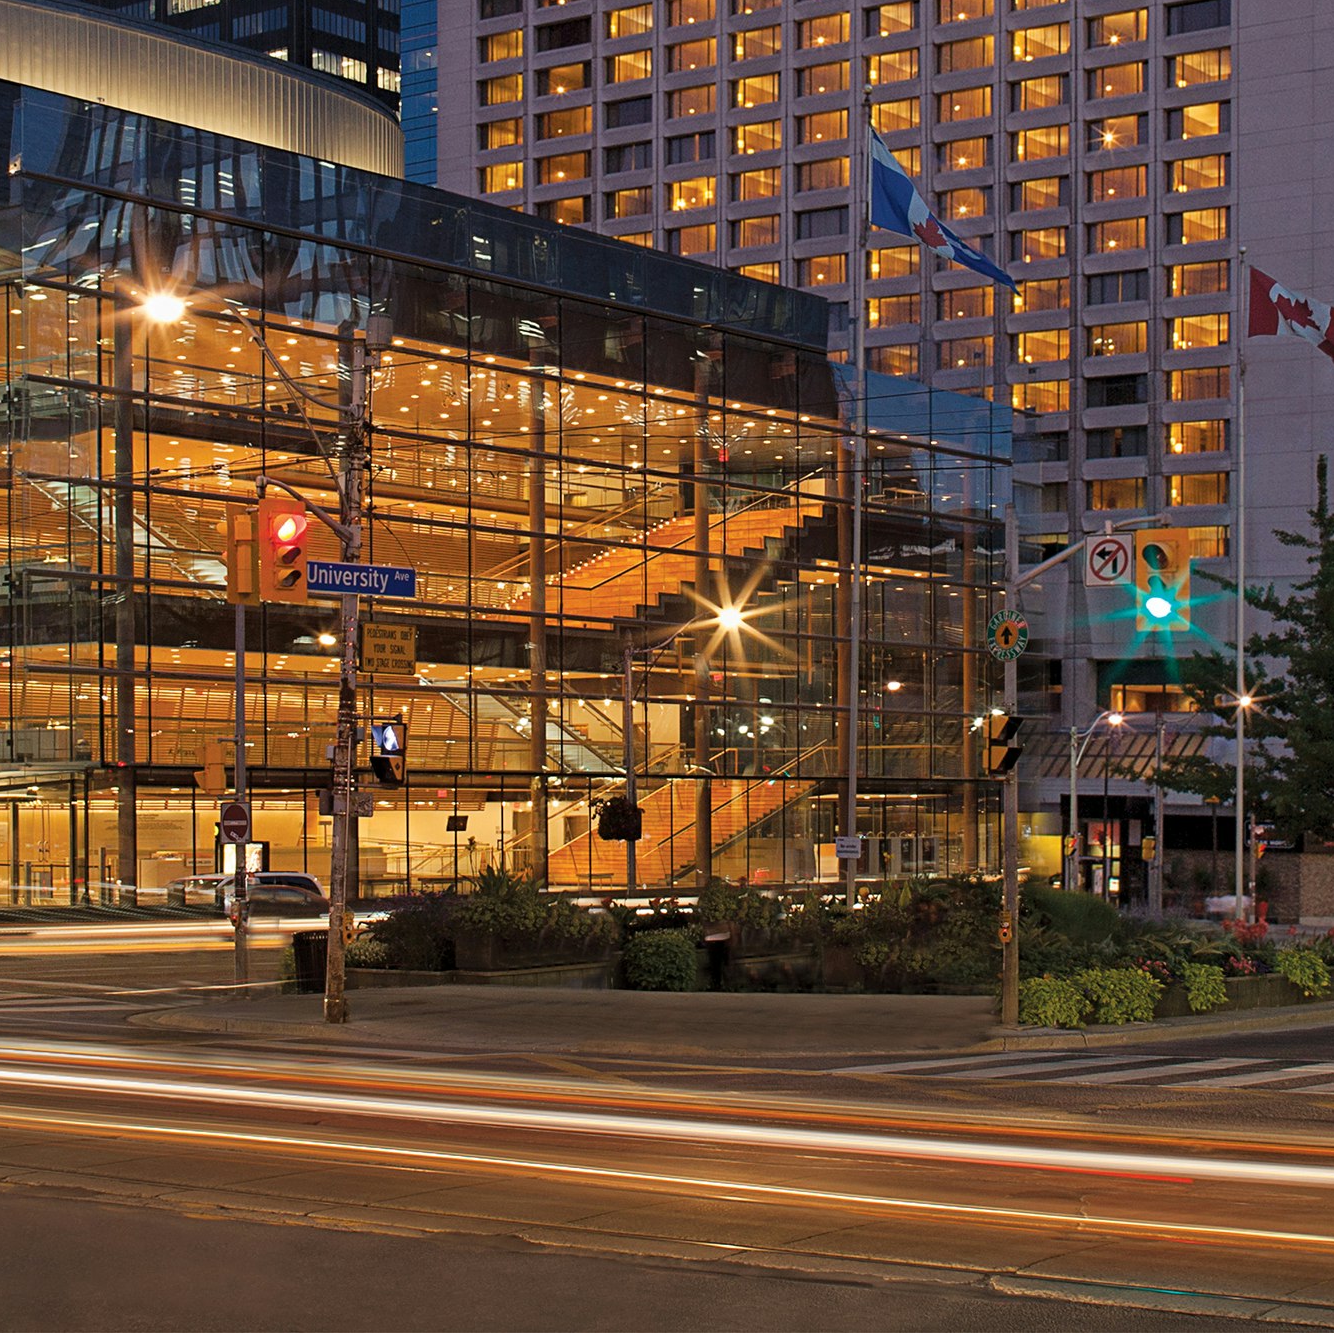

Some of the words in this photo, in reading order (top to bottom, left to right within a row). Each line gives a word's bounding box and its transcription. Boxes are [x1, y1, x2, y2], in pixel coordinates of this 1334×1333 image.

[307, 563, 389, 594] University
[394, 570, 410, 582] Ave
[367, 627, 397, 640] PEDESTRIANS
[400, 630, 413, 641] OBEY
[373, 644, 386, 653] YOUR
[389, 644, 406, 655] SIGNAL
[376, 657, 390, 668] STAGE
[392, 658, 413, 669] CROSSING
